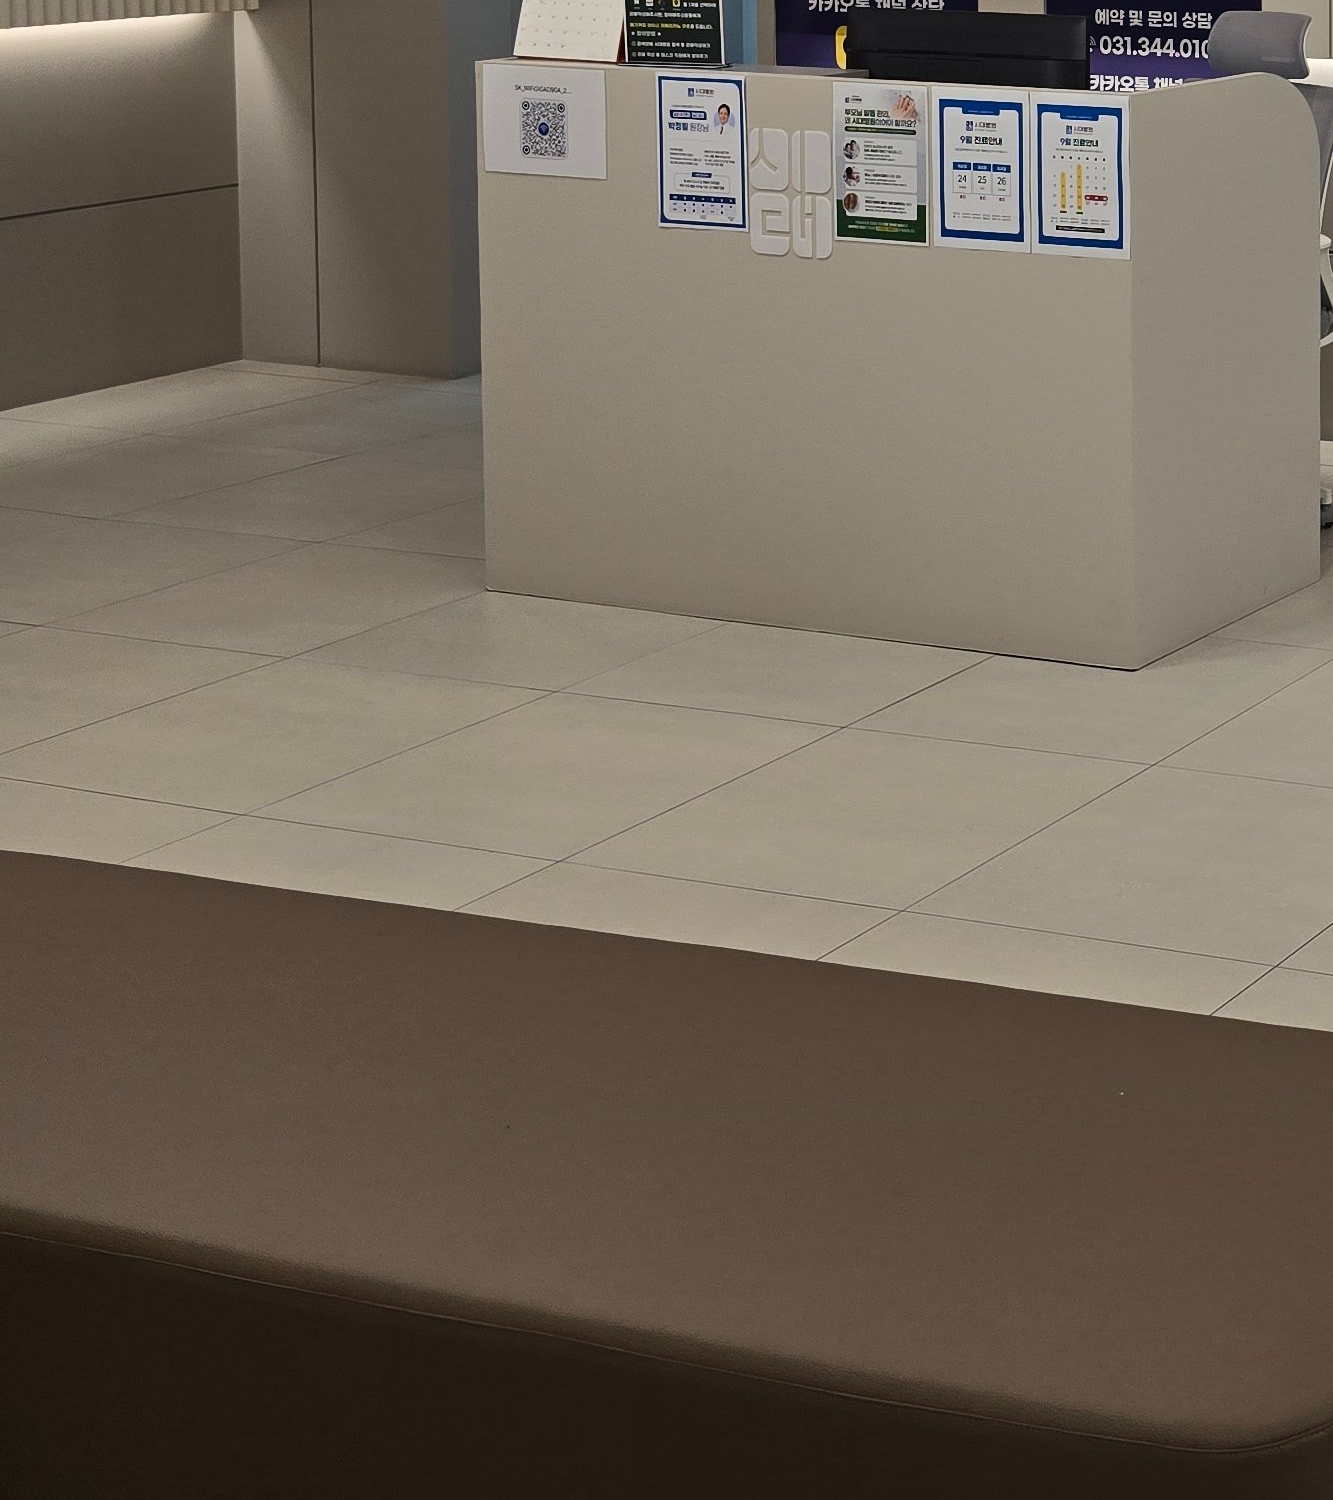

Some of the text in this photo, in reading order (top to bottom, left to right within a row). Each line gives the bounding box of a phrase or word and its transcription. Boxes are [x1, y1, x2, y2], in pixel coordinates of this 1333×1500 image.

[1095, 9, 1213, 30] 예약 및 문의 상담
[978, 176, 987, 184] 25
[997, 177, 1006, 185] 26
